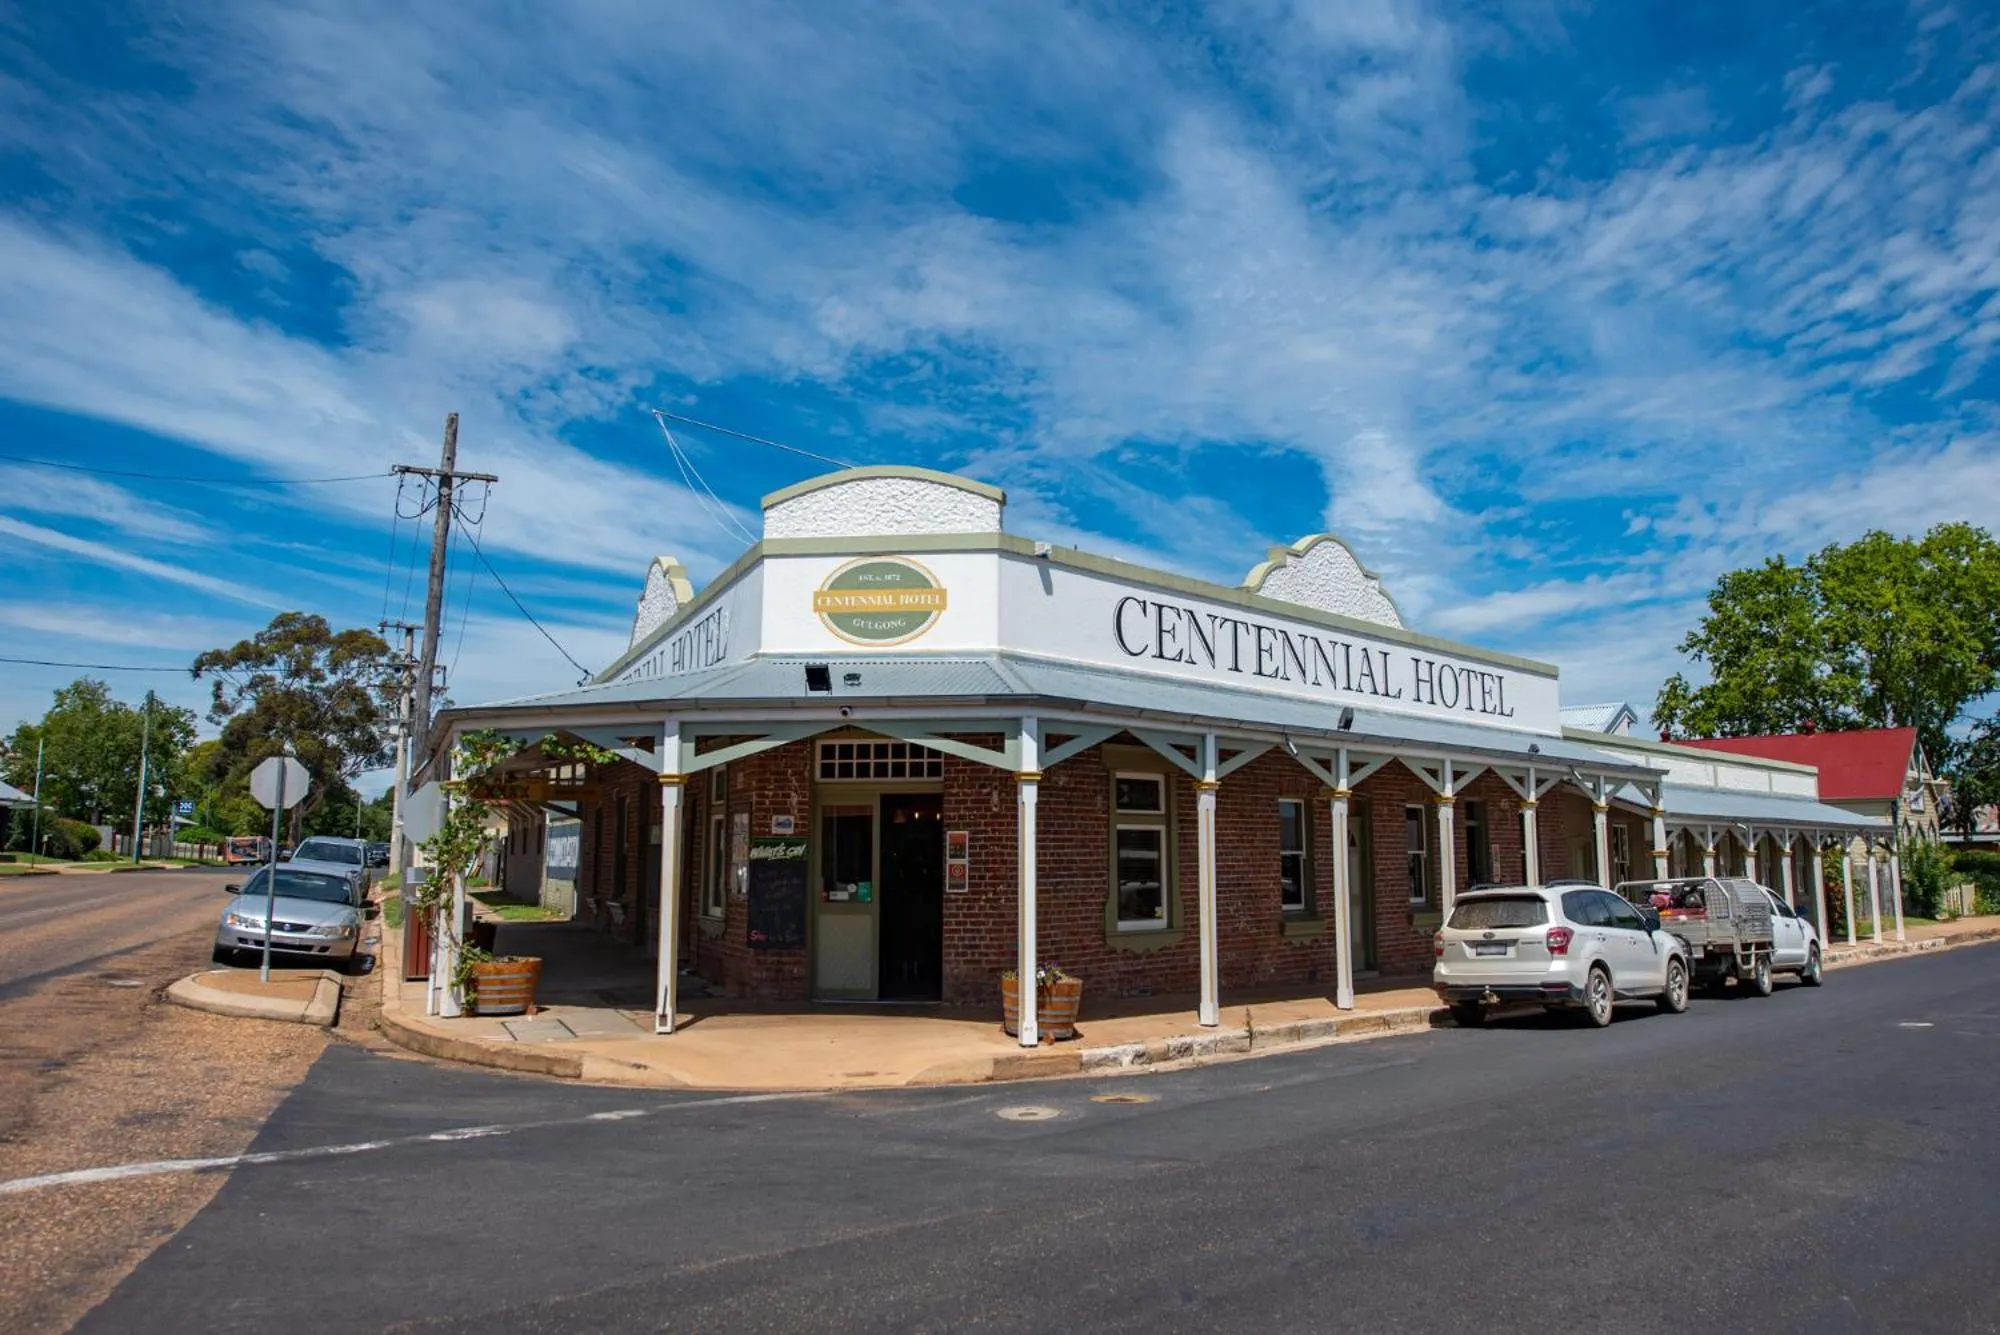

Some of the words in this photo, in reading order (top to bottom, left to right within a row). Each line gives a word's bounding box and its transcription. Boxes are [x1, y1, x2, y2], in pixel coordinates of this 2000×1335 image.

[817, 594, 896, 607] CENTENNIAL
[899, 593, 941, 606] HOTEL
[672, 606, 728, 673] HOTEL
[852, 617, 906, 630] GULGONG
[1113, 596, 1402, 699] CENTENNIAL
[1410, 657, 1514, 718] HOTEL
